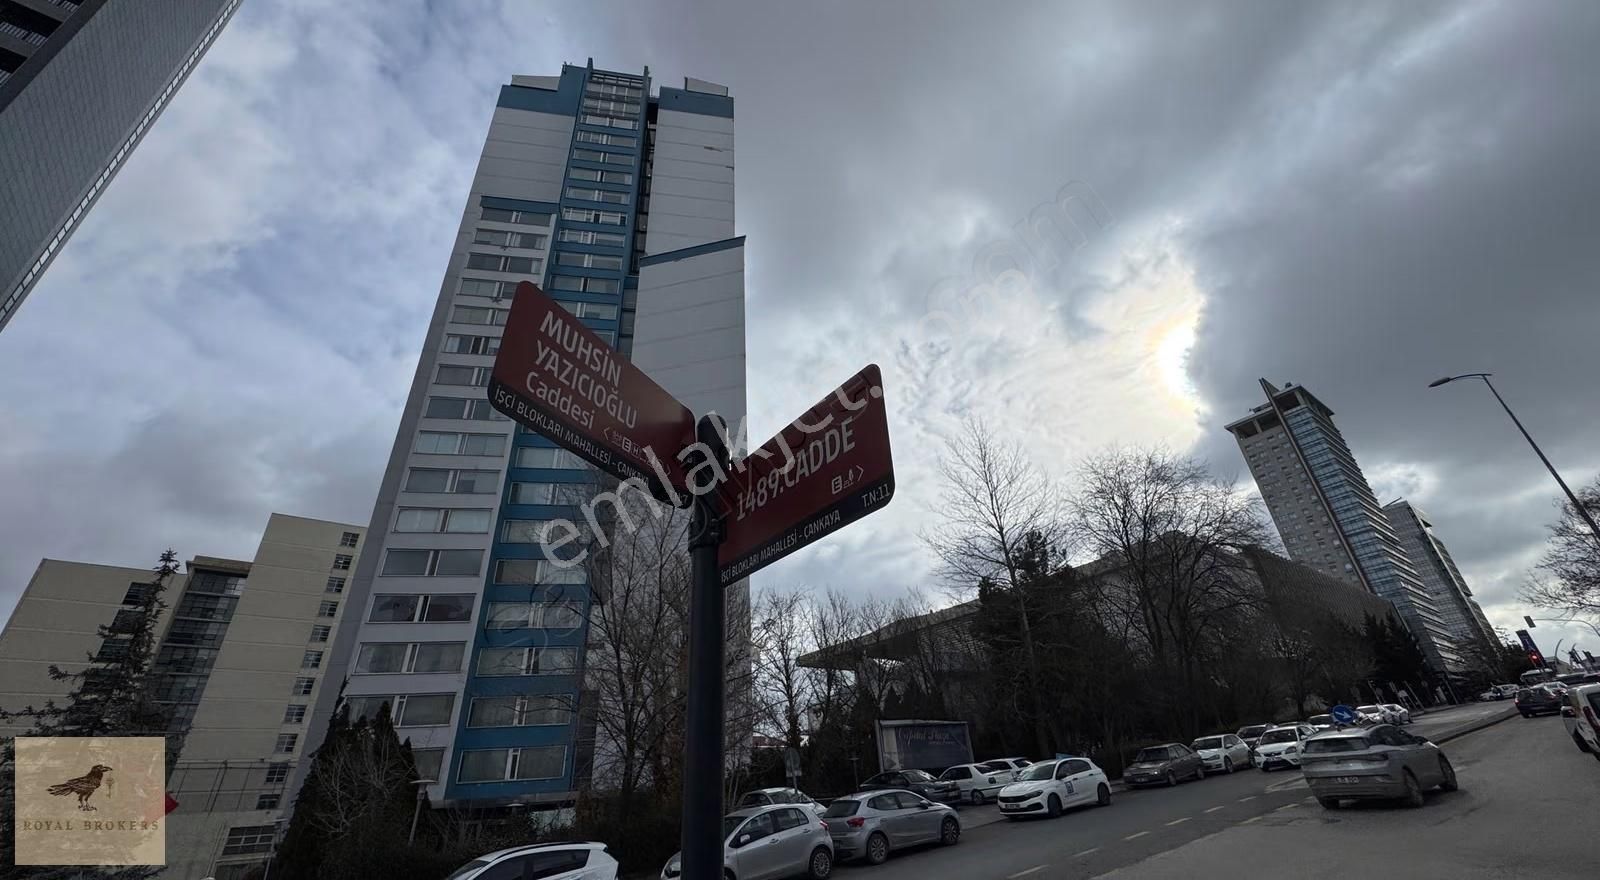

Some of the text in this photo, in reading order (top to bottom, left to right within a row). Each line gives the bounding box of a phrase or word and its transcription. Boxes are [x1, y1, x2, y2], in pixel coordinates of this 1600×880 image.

[535, 339, 637, 429] YAZICIOĞLU
[540, 310, 622, 388] MUHSİN
[494, 384, 516, 409] İŞÇİ
[517, 401, 563, 437] BLOKLARI
[565, 430, 611, 465] MAHALLESİ
[525, 371, 595, 430] Caddesi
[732, 555, 760, 577] BLOKLARI
[761, 529, 797, 559] MAHALLESİ
[803, 510, 840, 539] ÇANKAYA
